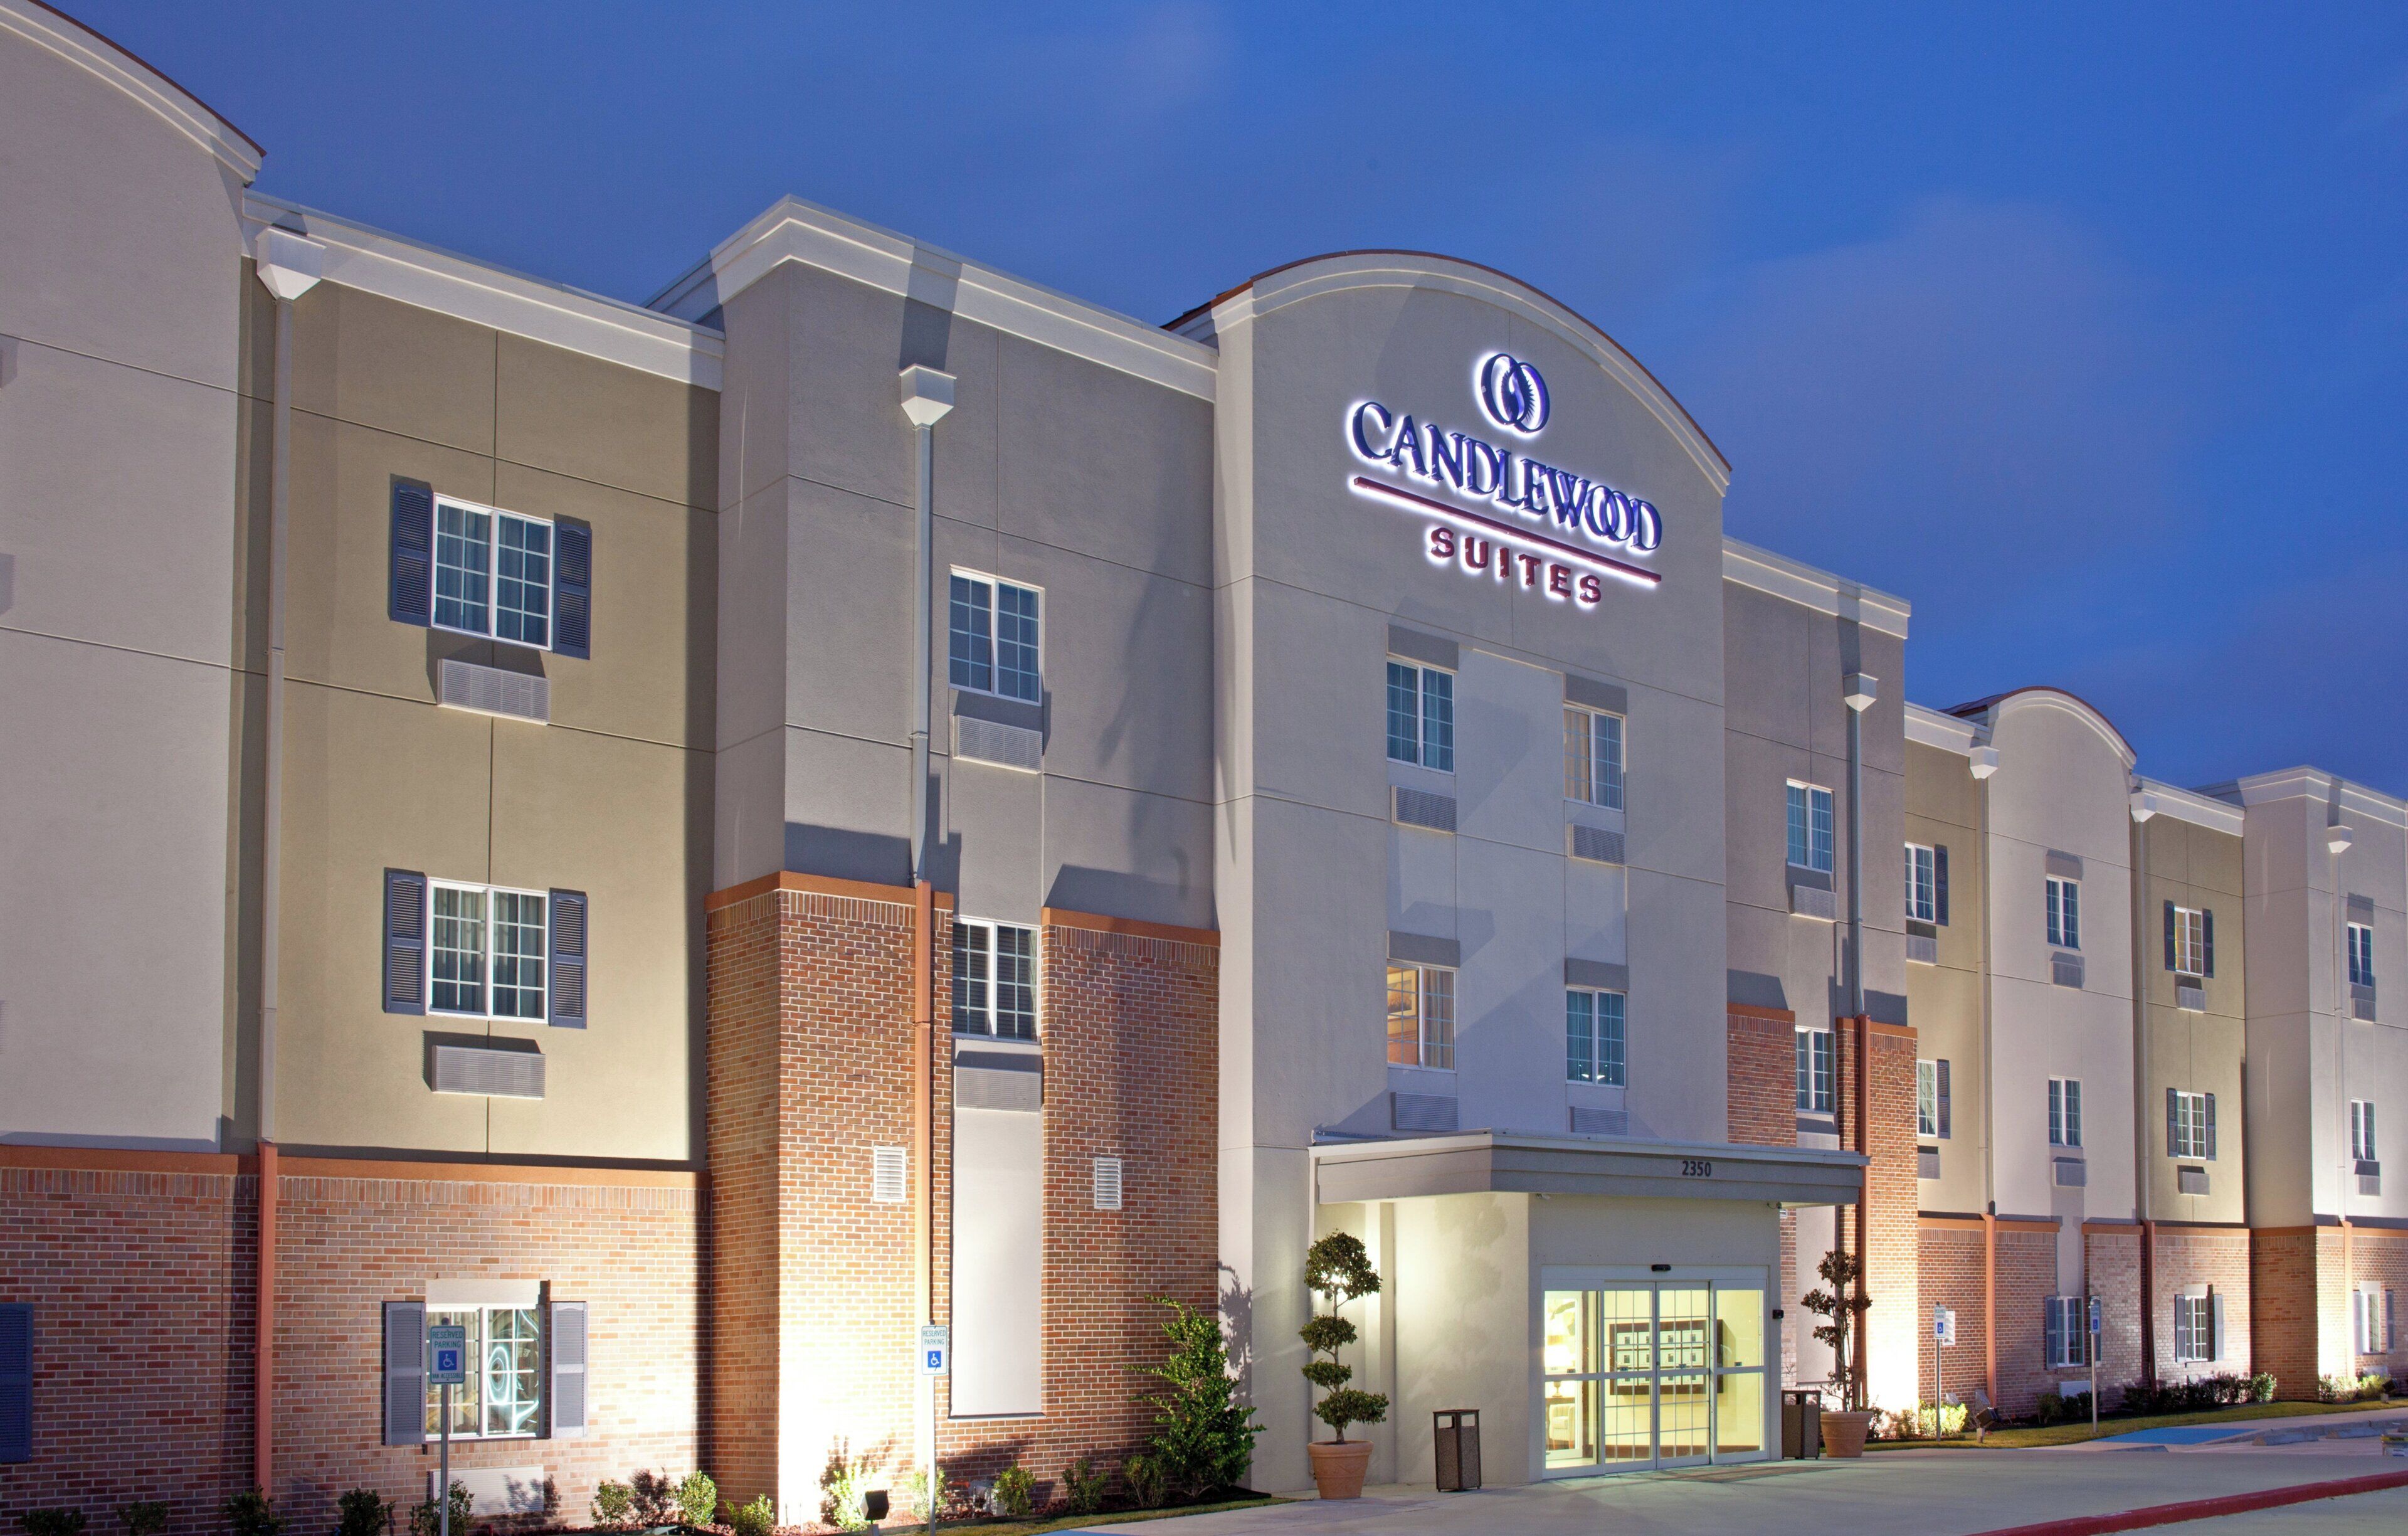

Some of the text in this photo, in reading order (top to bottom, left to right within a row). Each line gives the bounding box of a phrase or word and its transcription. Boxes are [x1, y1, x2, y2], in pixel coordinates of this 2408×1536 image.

[1351, 401, 1662, 551] CANDLEWOOD
[1430, 527, 1602, 604] SUITES
[1682, 1160, 1712, 1177] 2350
